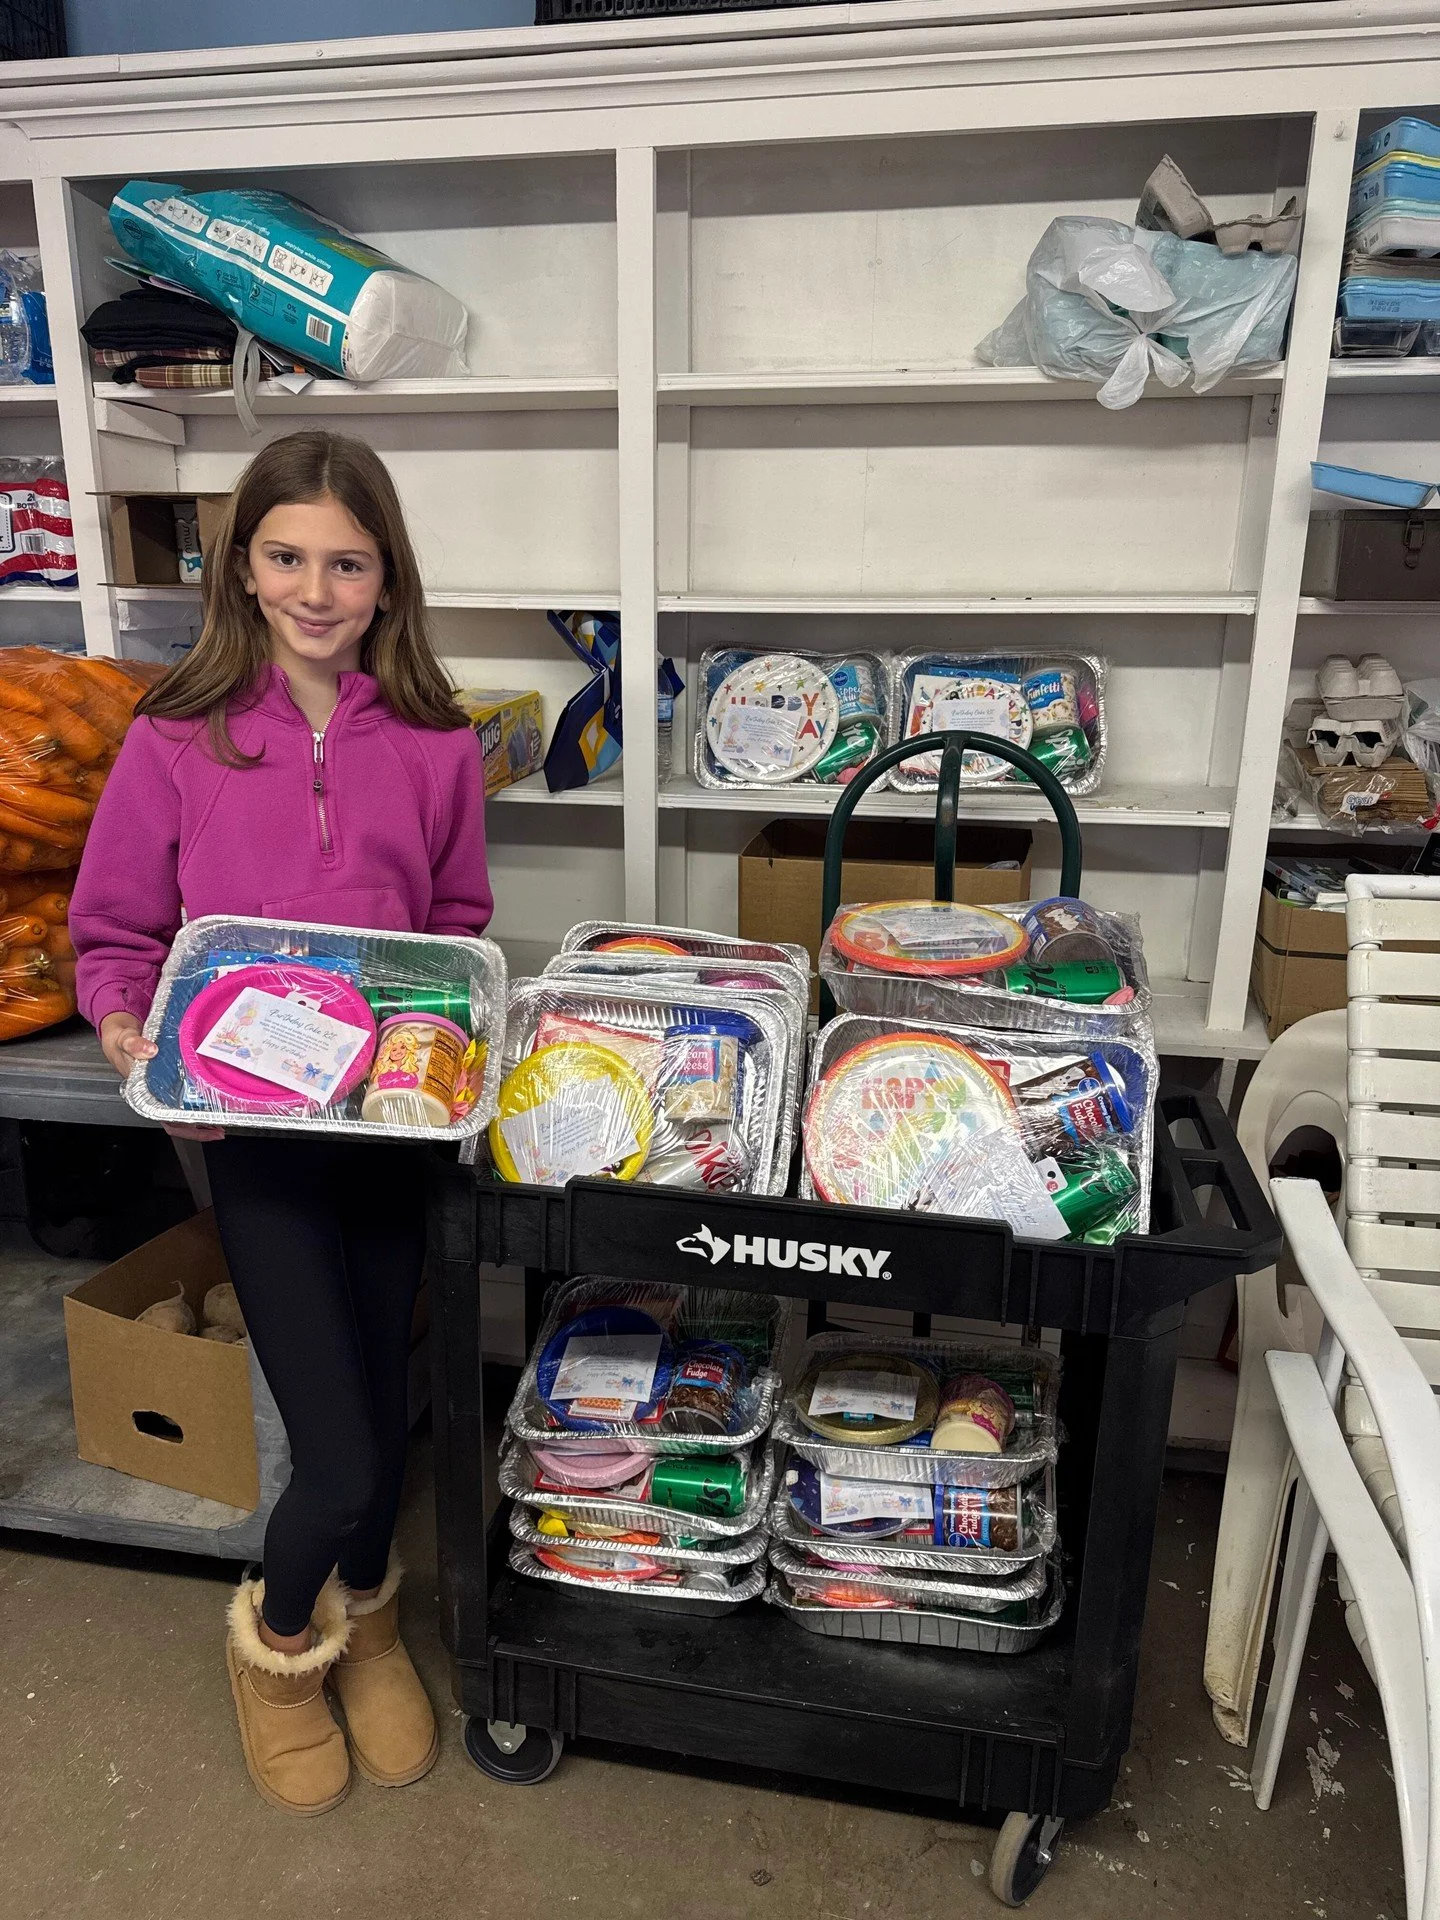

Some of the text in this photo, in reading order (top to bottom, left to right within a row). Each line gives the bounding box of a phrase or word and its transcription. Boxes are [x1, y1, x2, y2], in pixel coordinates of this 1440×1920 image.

[285, 241, 331, 269] applying while sitting
[287, 303, 297, 313] 0%
[1028, 681, 1060, 700] Funfetti
[268, 1006, 337, 1041] Birthday Cake Kit
[861, 1076, 967, 1109] HAPPY
[1072, 1103, 1088, 1130] Fudge
[734, 1234, 892, 1278] HUSKY
[686, 1368, 708, 1378] Fudge
[689, 1361, 723, 1373] Chocolate
[958, 1493, 969, 1534] Chocolate
[970, 1509, 981, 1535] Fudge
